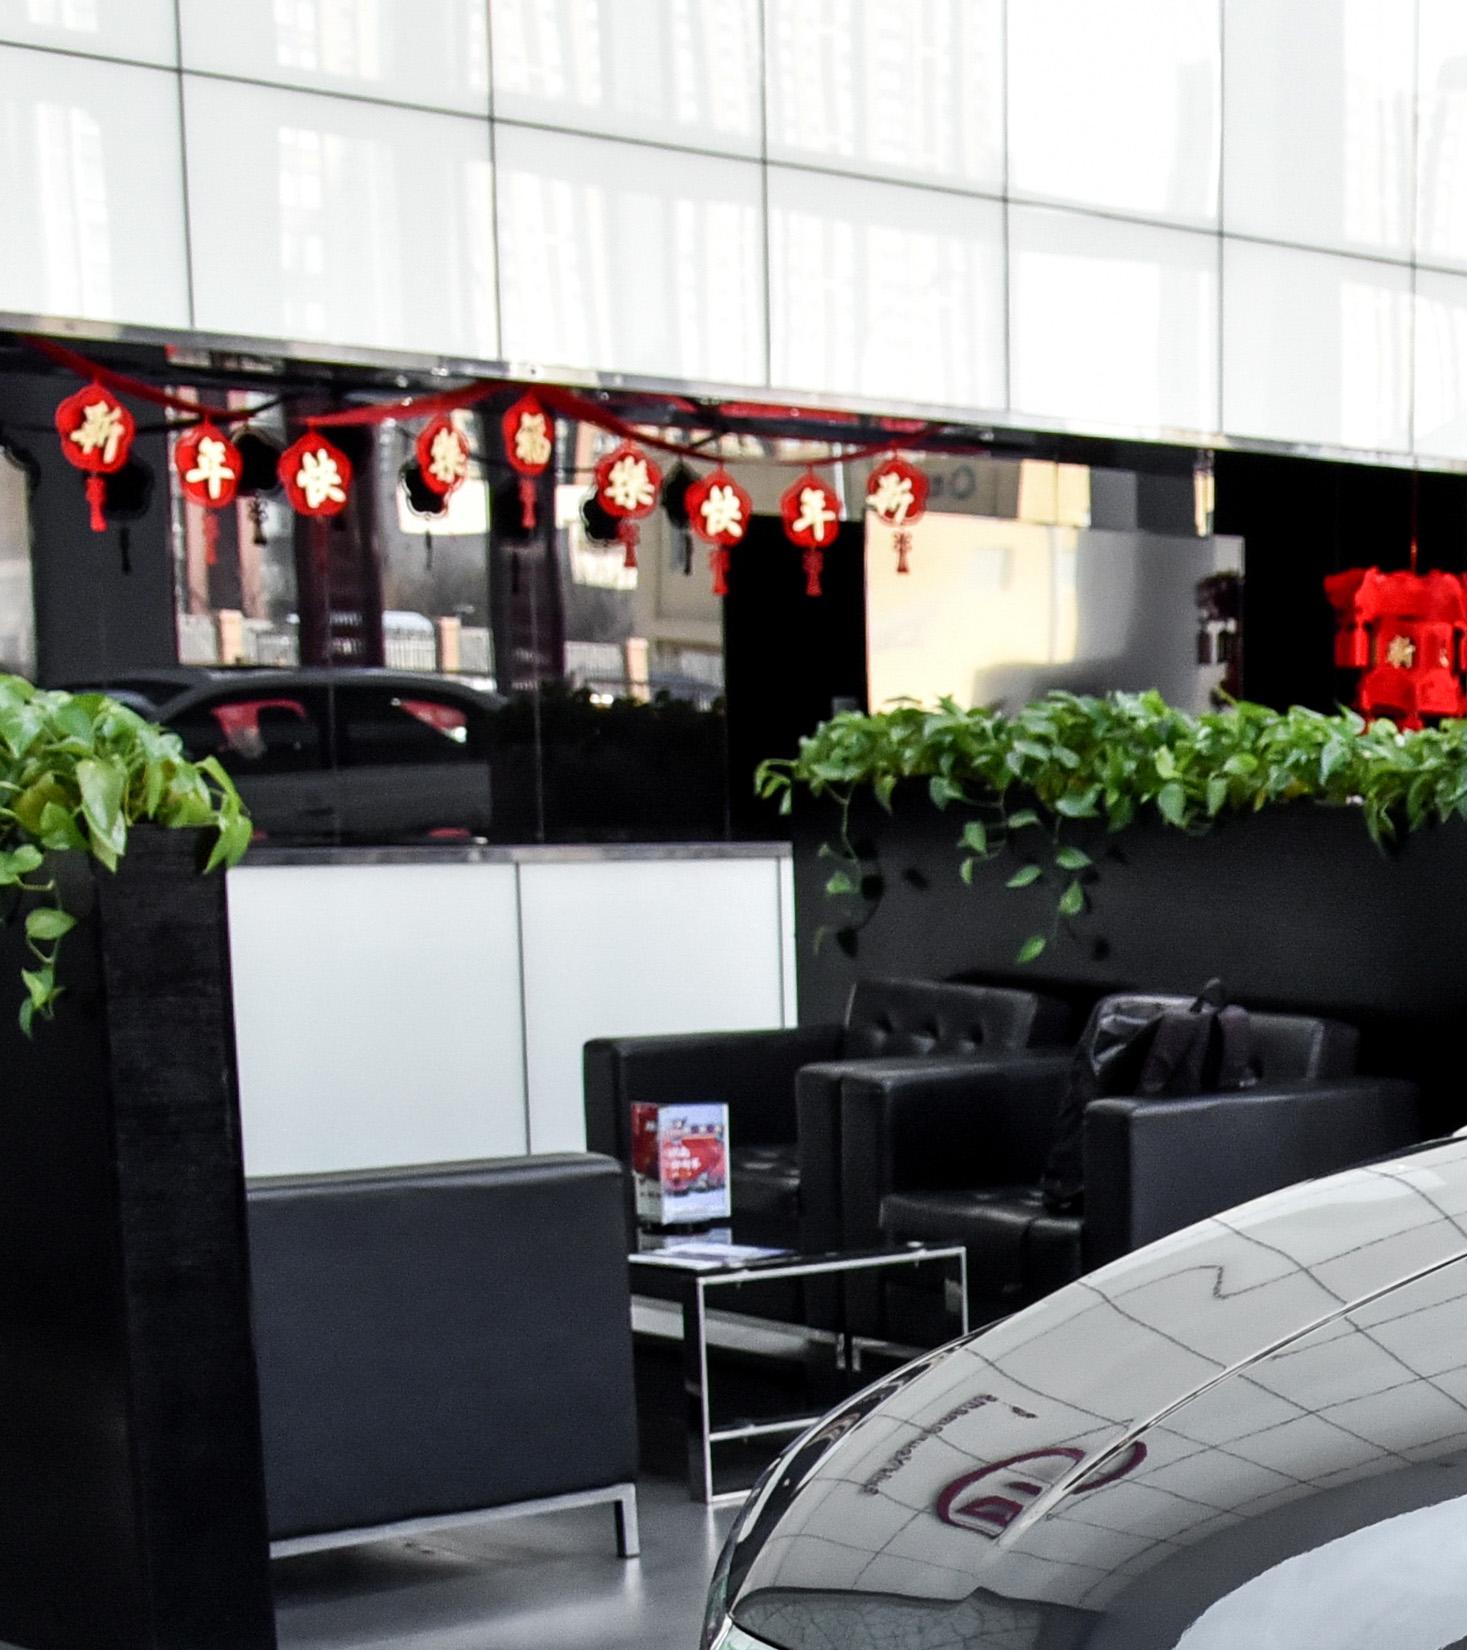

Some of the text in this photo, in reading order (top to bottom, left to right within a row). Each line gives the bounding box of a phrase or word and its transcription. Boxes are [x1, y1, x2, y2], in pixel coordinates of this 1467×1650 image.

[185, 436, 234, 499] 年
[296, 448, 346, 508] 快
[701, 485, 743, 537] 快
[792, 487, 836, 541] 年
